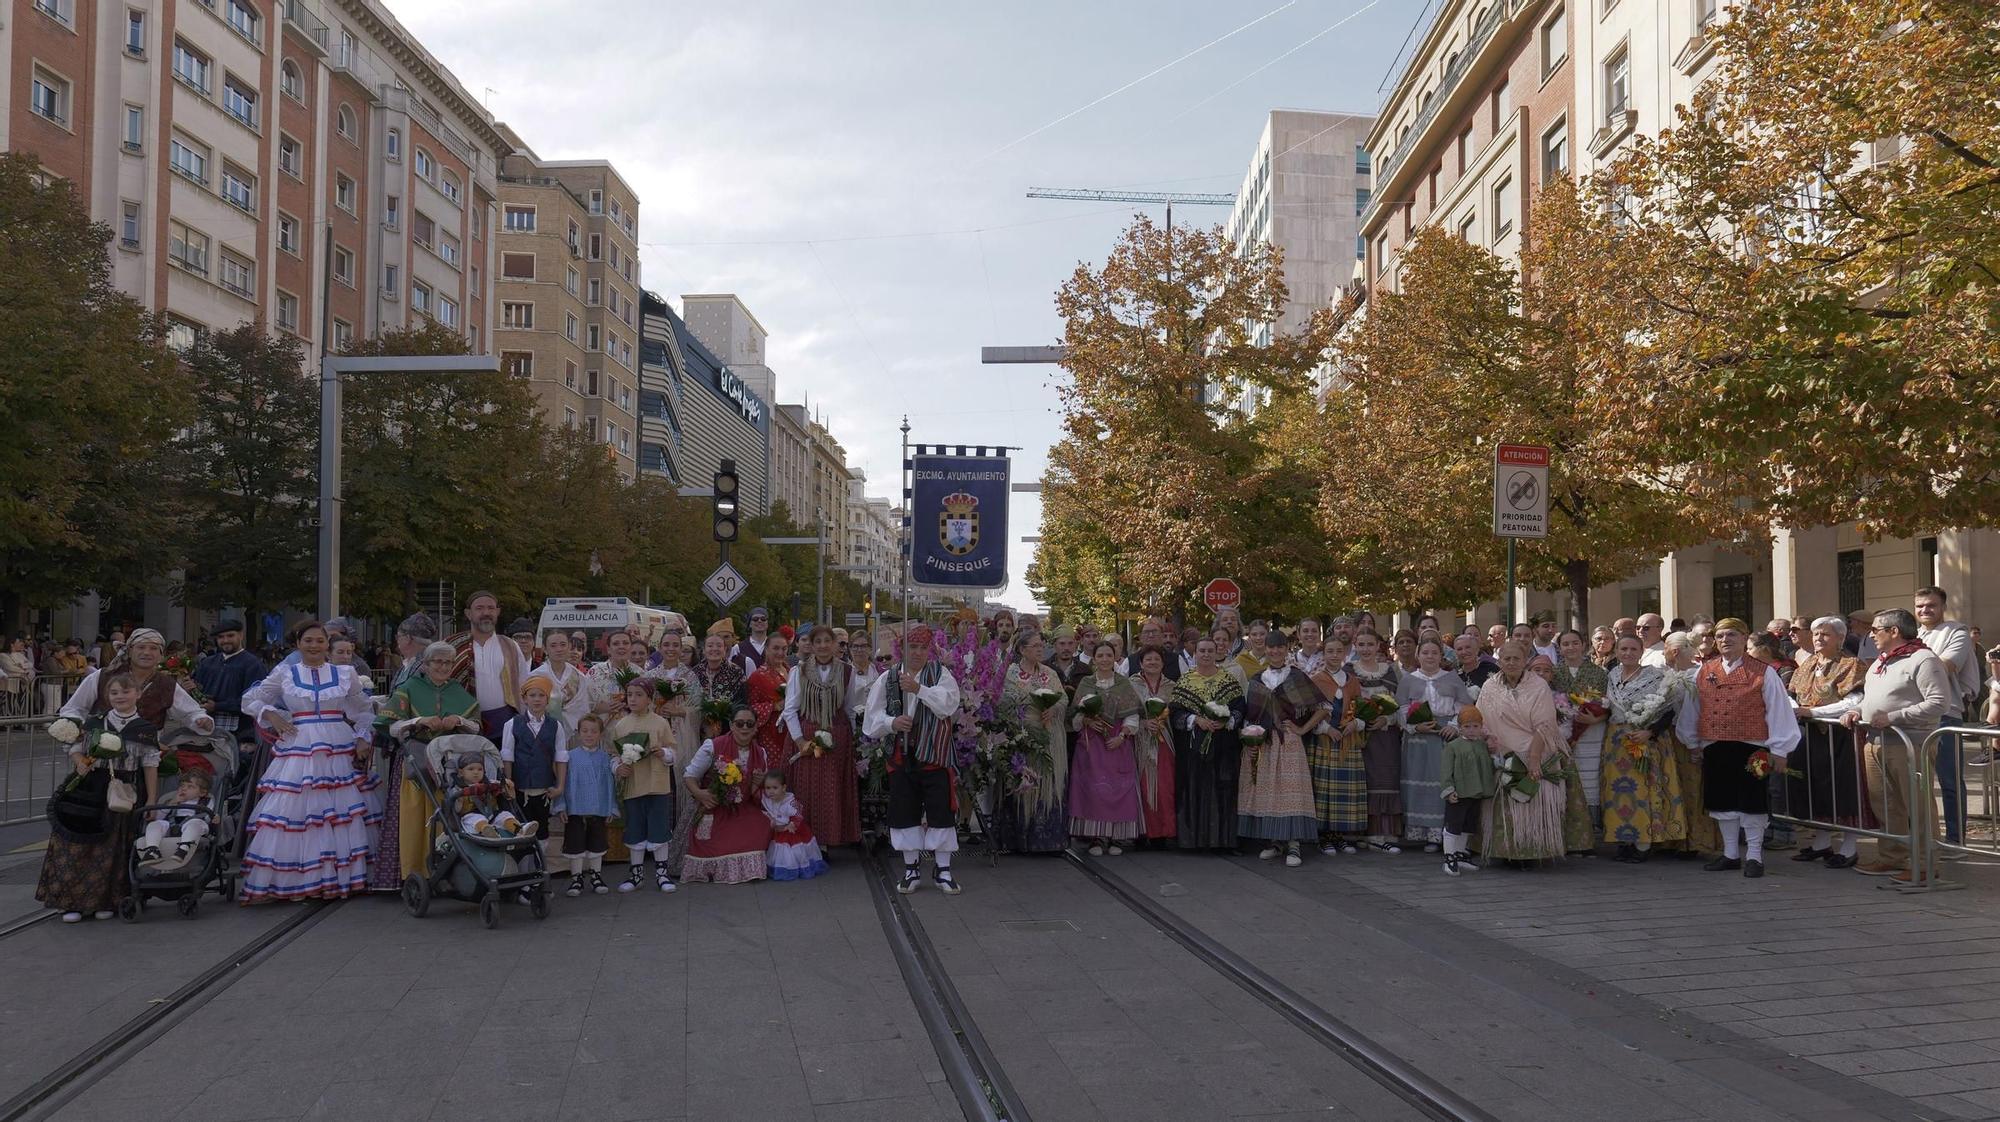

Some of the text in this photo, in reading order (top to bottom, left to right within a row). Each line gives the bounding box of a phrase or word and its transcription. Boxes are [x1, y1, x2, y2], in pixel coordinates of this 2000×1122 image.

[916, 470, 1006, 481] EXCMO. AYUNTAMIENTO
[1502, 513, 1542, 521] PRIORIDAD
[1502, 524, 1542, 532] PEATONAL
[926, 555, 991, 572] PINSEQUE
[717, 576, 735, 591] 30
[1209, 592, 1237, 600] STOP
[552, 613, 619, 621] AMBULANCIA
